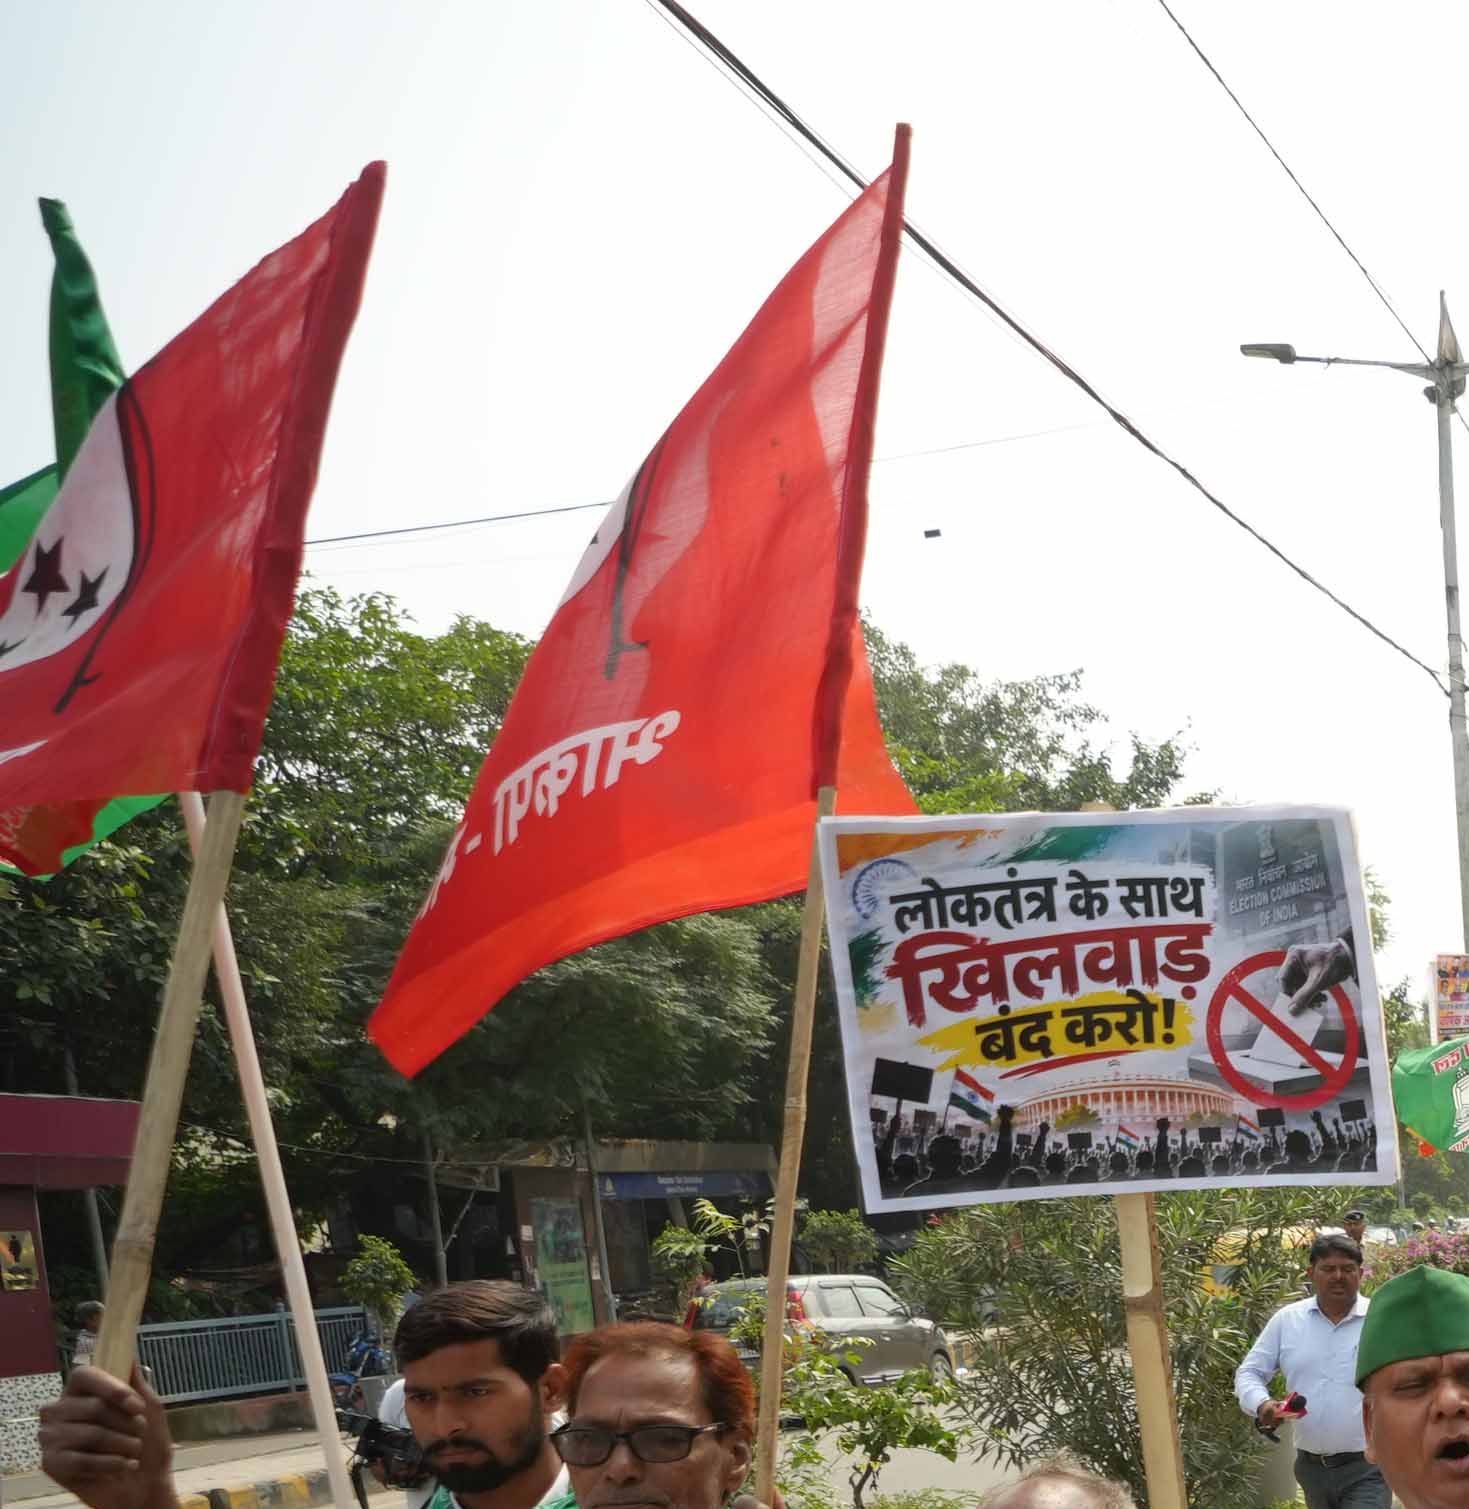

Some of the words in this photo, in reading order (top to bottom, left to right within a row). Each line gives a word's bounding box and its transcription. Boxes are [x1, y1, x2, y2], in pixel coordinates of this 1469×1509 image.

[889, 866, 1058, 935] लोकतंत्र
[1065, 869, 1110, 921] के
[1115, 876, 1205, 919] साथ
[882, 921, 1216, 1029] खिलवाड़
[974, 1003, 1054, 1062] बंद
[1060, 988, 1177, 1046] करो!
